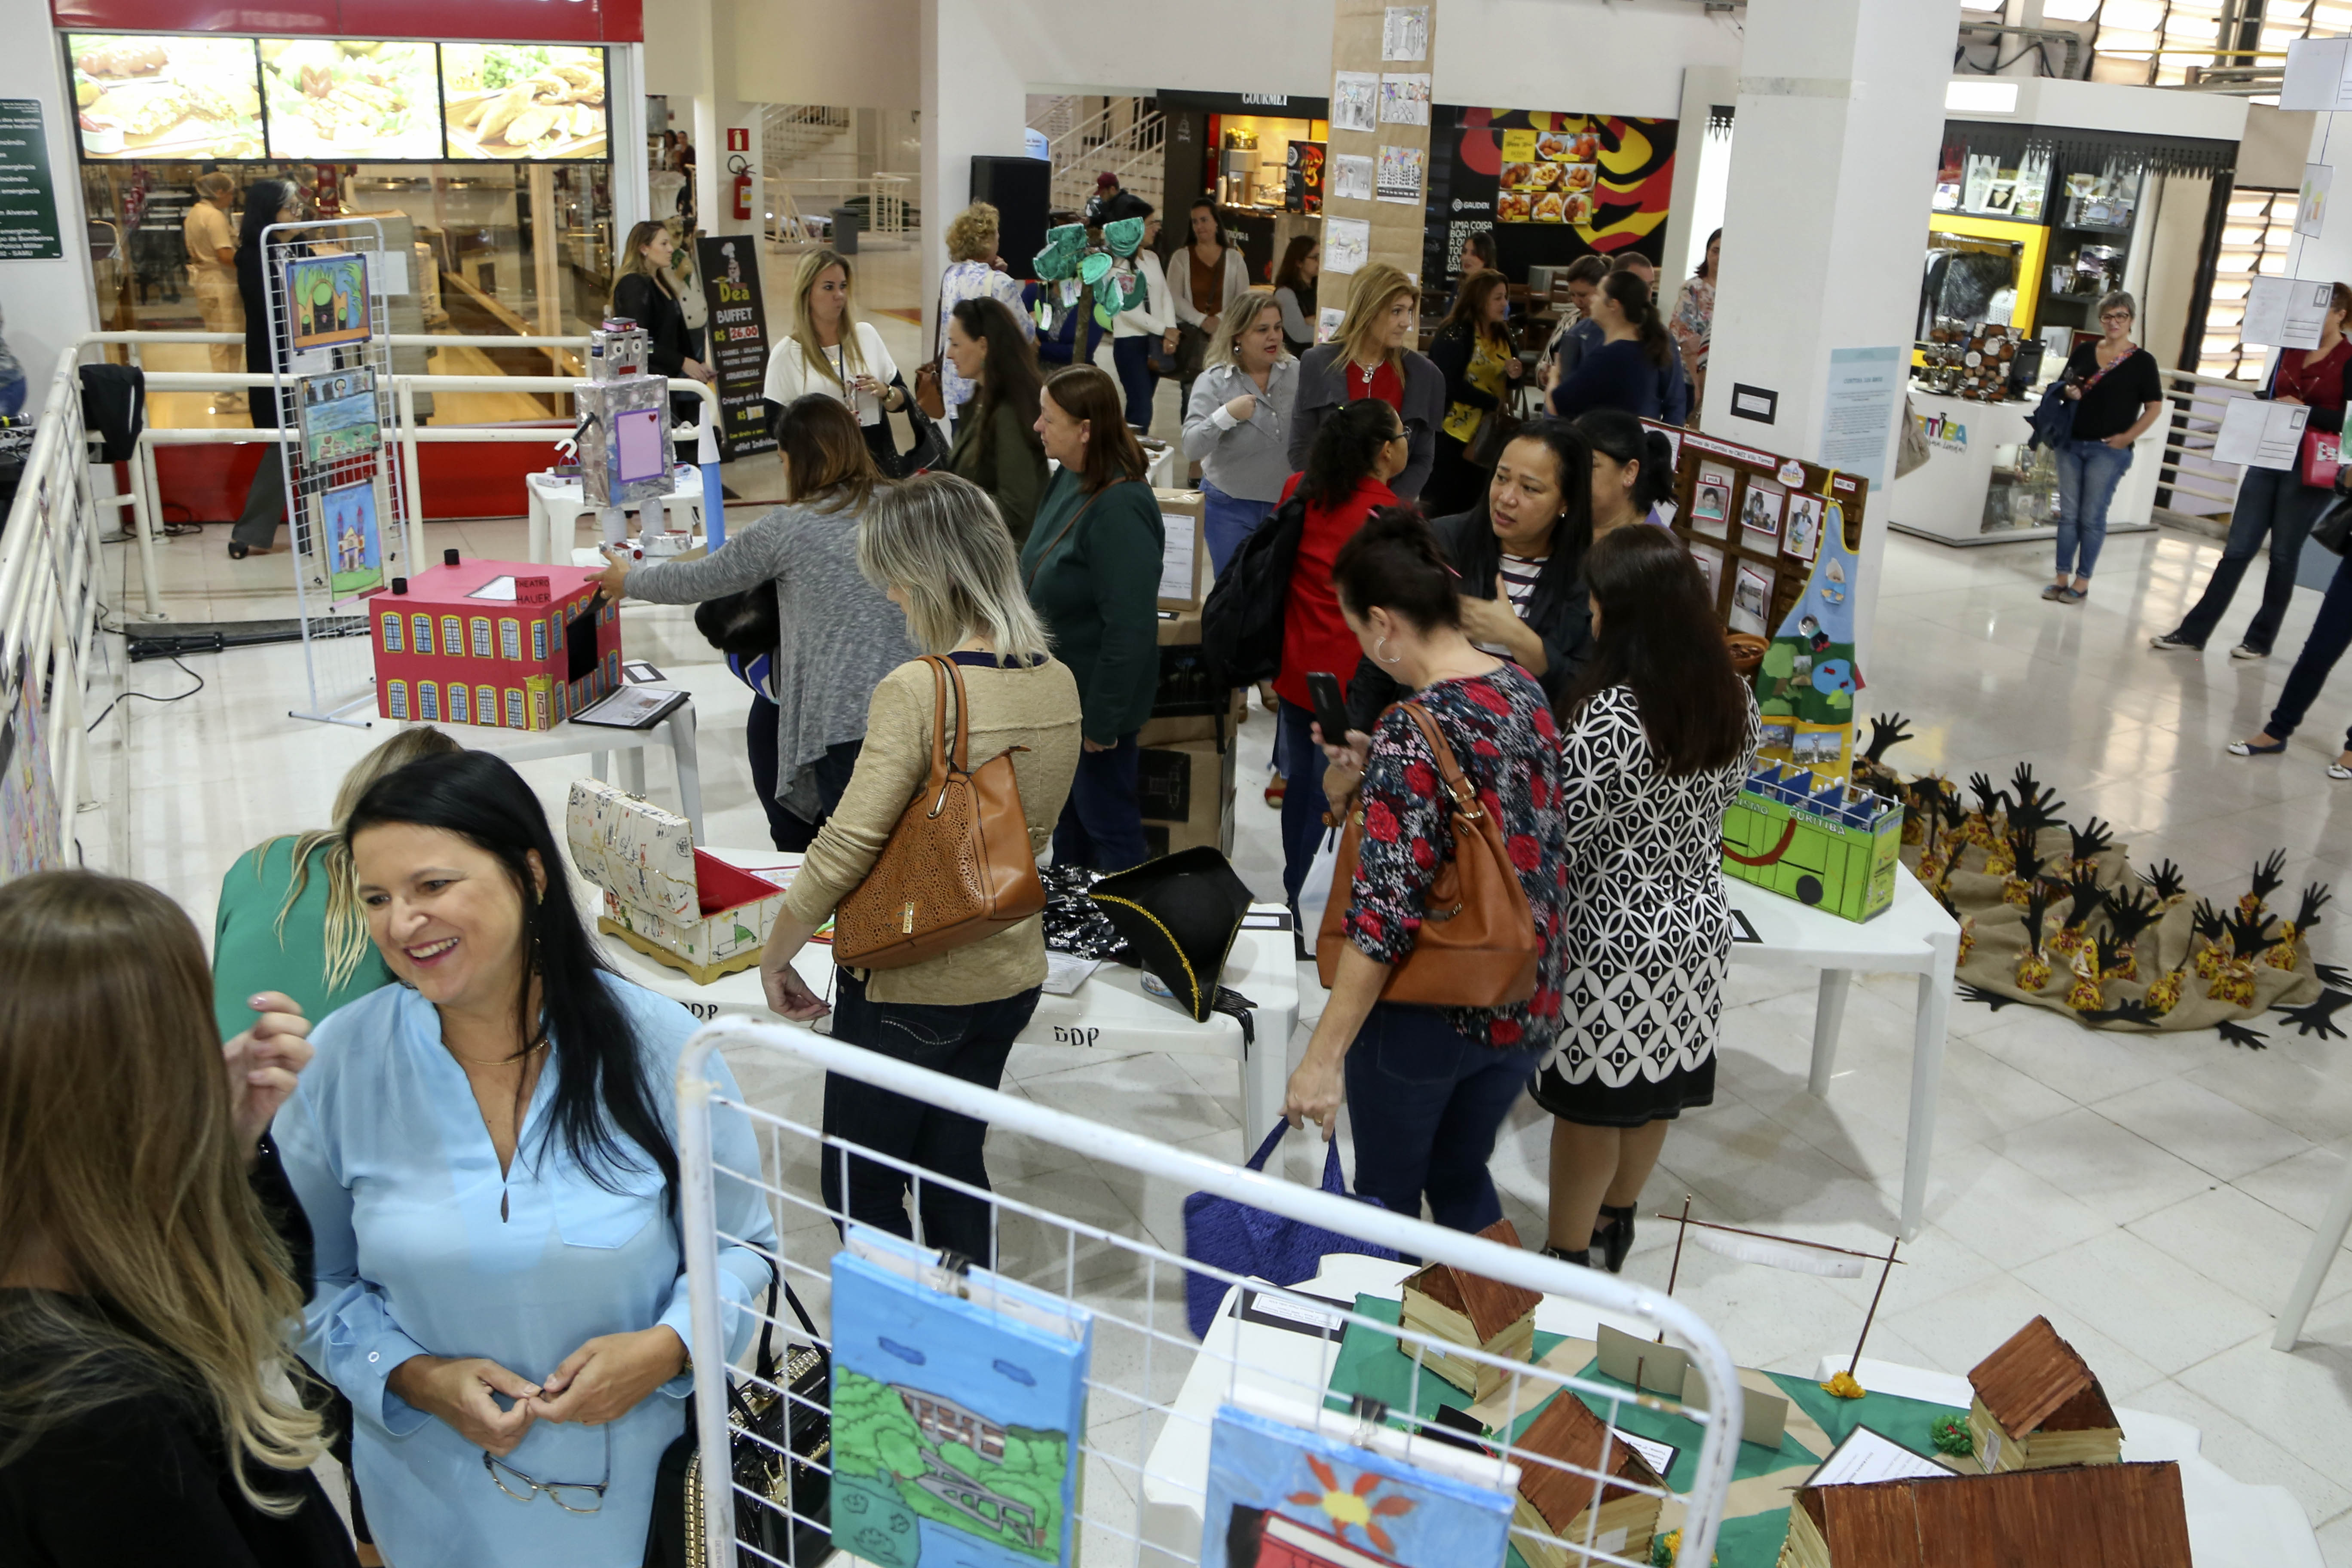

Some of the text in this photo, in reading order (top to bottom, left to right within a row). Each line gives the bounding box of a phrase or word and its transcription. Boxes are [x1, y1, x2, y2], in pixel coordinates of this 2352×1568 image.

[1451, 220, 1493, 230] UMA COISA
[1450, 230, 1467, 238] BOA
[719, 282, 750, 303] Dea
[716, 307, 753, 324] BUFFET
[714, 329, 726, 342] R$
[515, 579, 550, 588] THEATRO
[516, 594, 551, 604] HAUER
[1789, 808, 1846, 836] CURITIBA
[679, 1001, 719, 1020] DP
[1054, 1026, 1099, 1047] DDP
